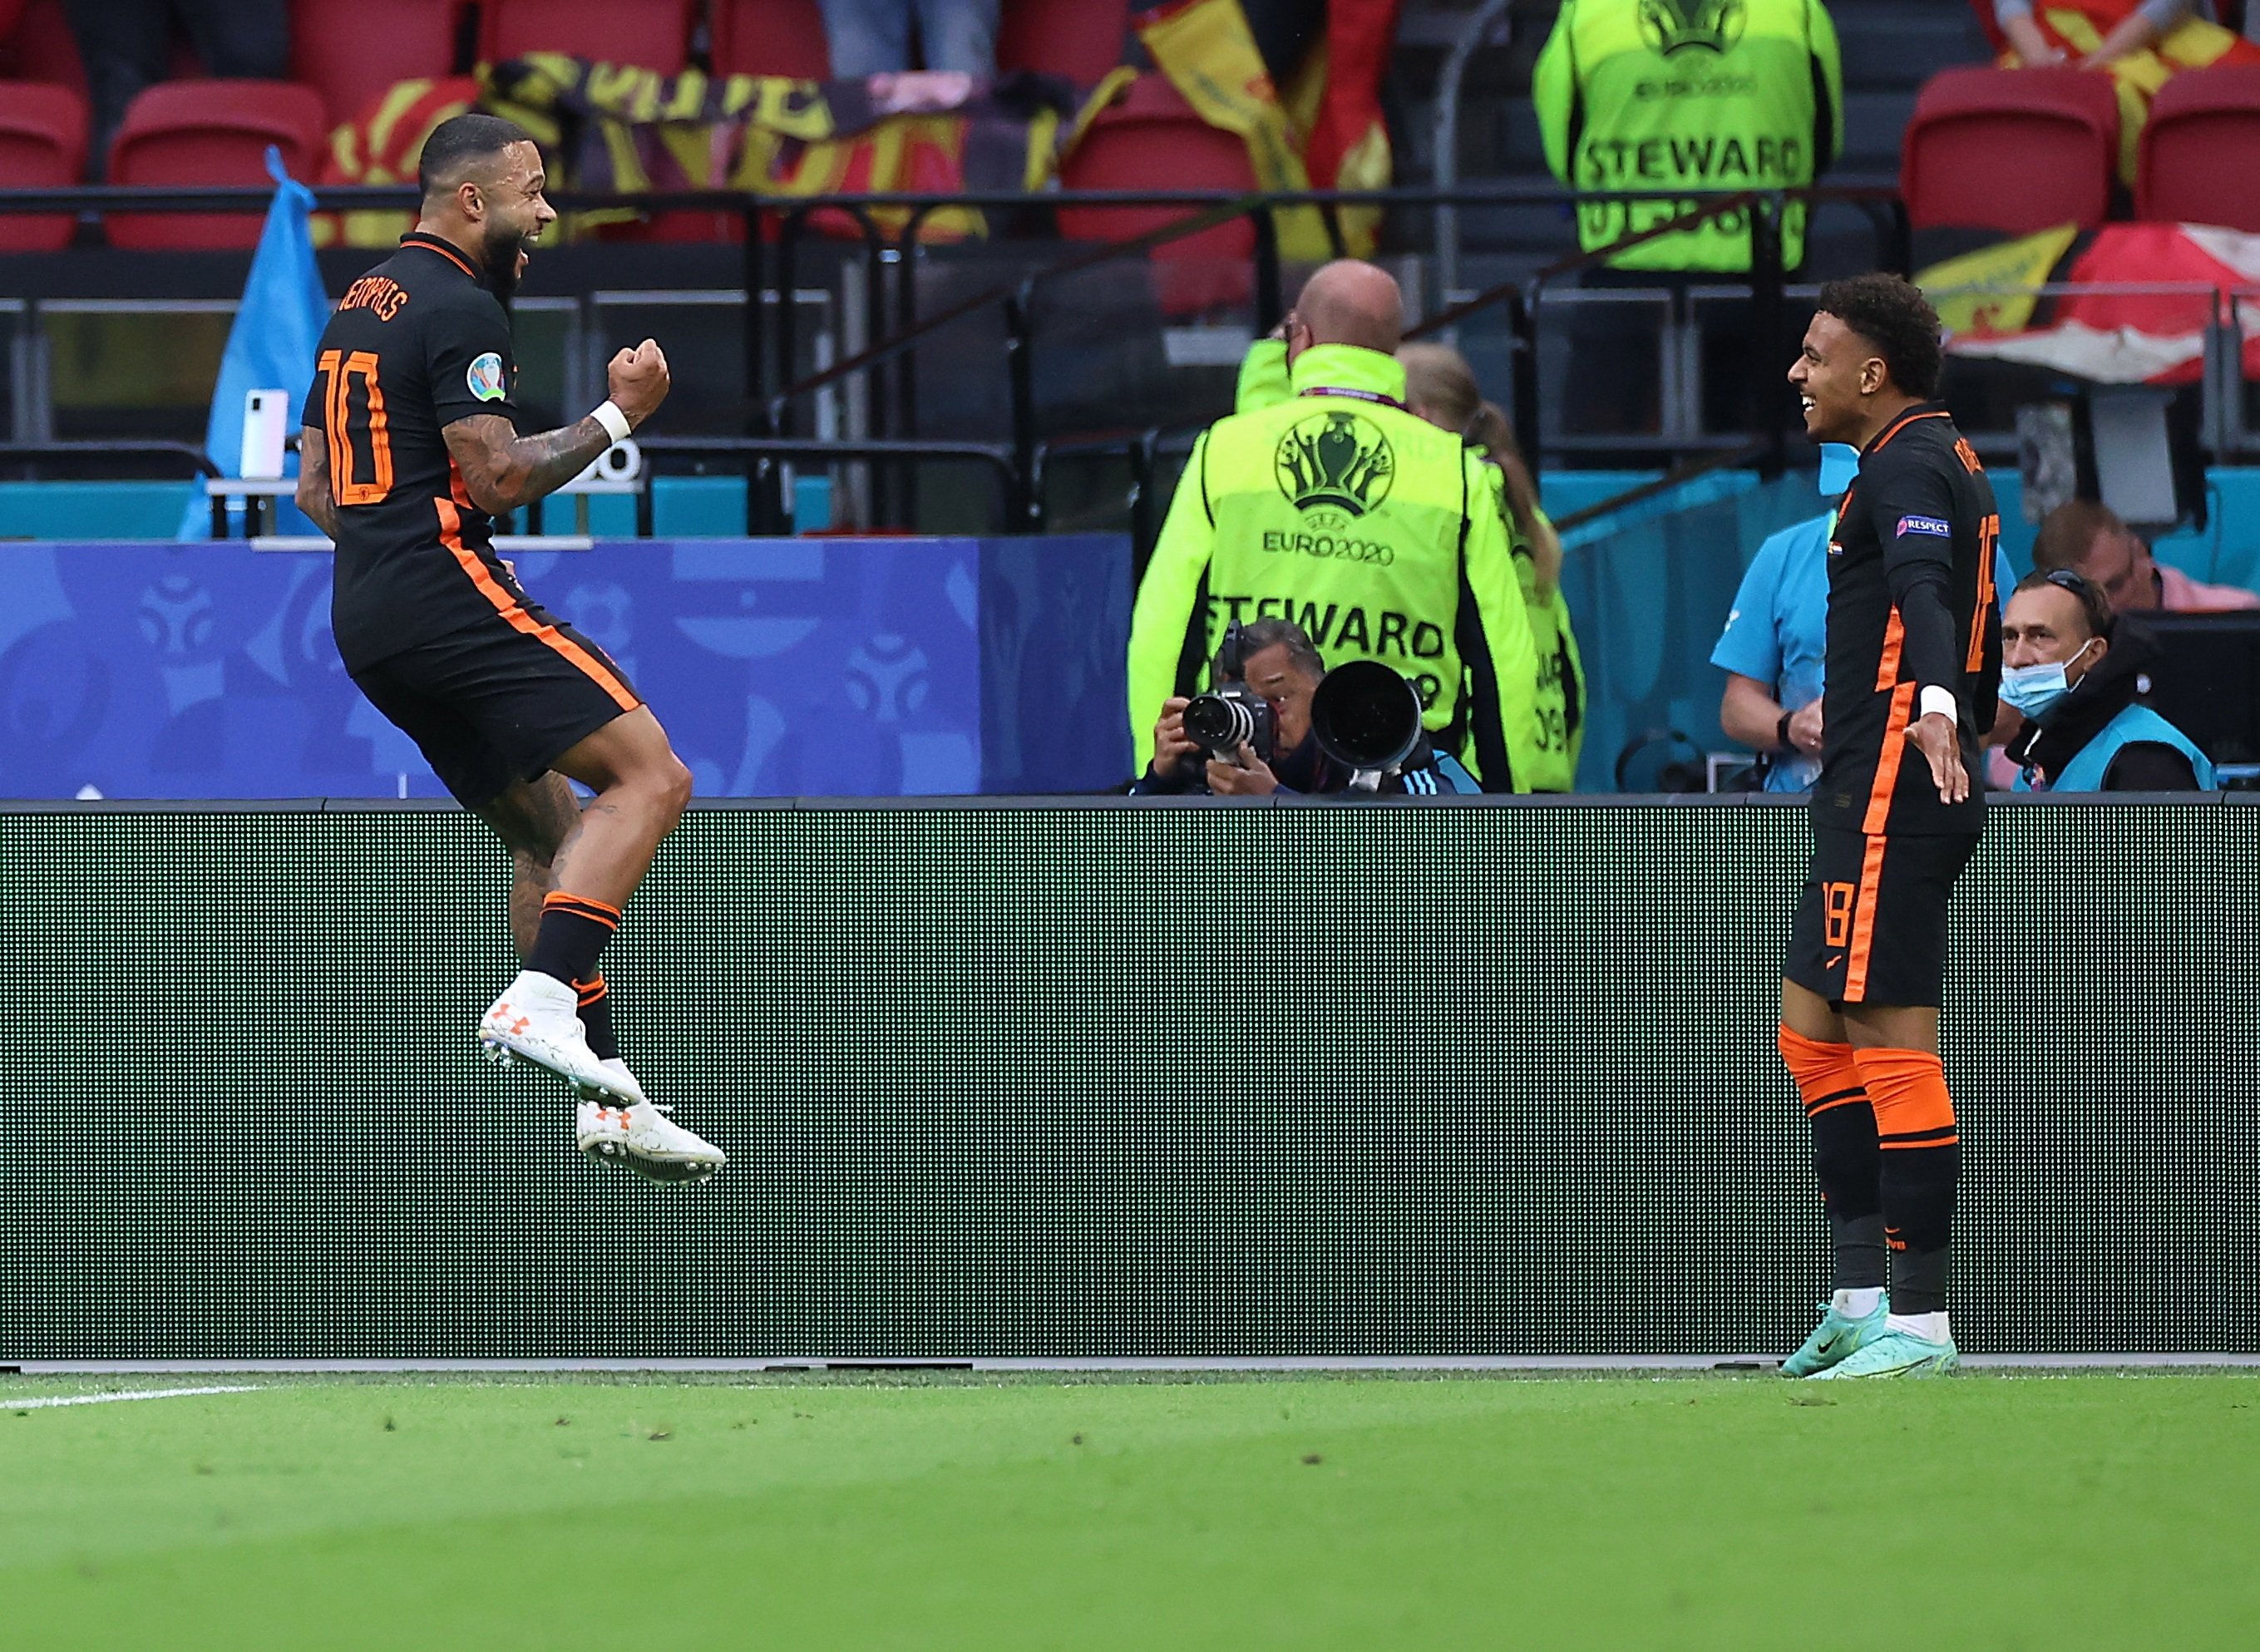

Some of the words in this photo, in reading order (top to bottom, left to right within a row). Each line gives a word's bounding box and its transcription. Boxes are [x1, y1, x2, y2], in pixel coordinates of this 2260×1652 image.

[1587, 137, 1800, 180] STEWARD
[318, 349, 392, 506] 10
[1907, 520, 1949, 533] RESPECT
[1263, 532, 1394, 566] EURO2020
[1822, 881, 1855, 948] 18
